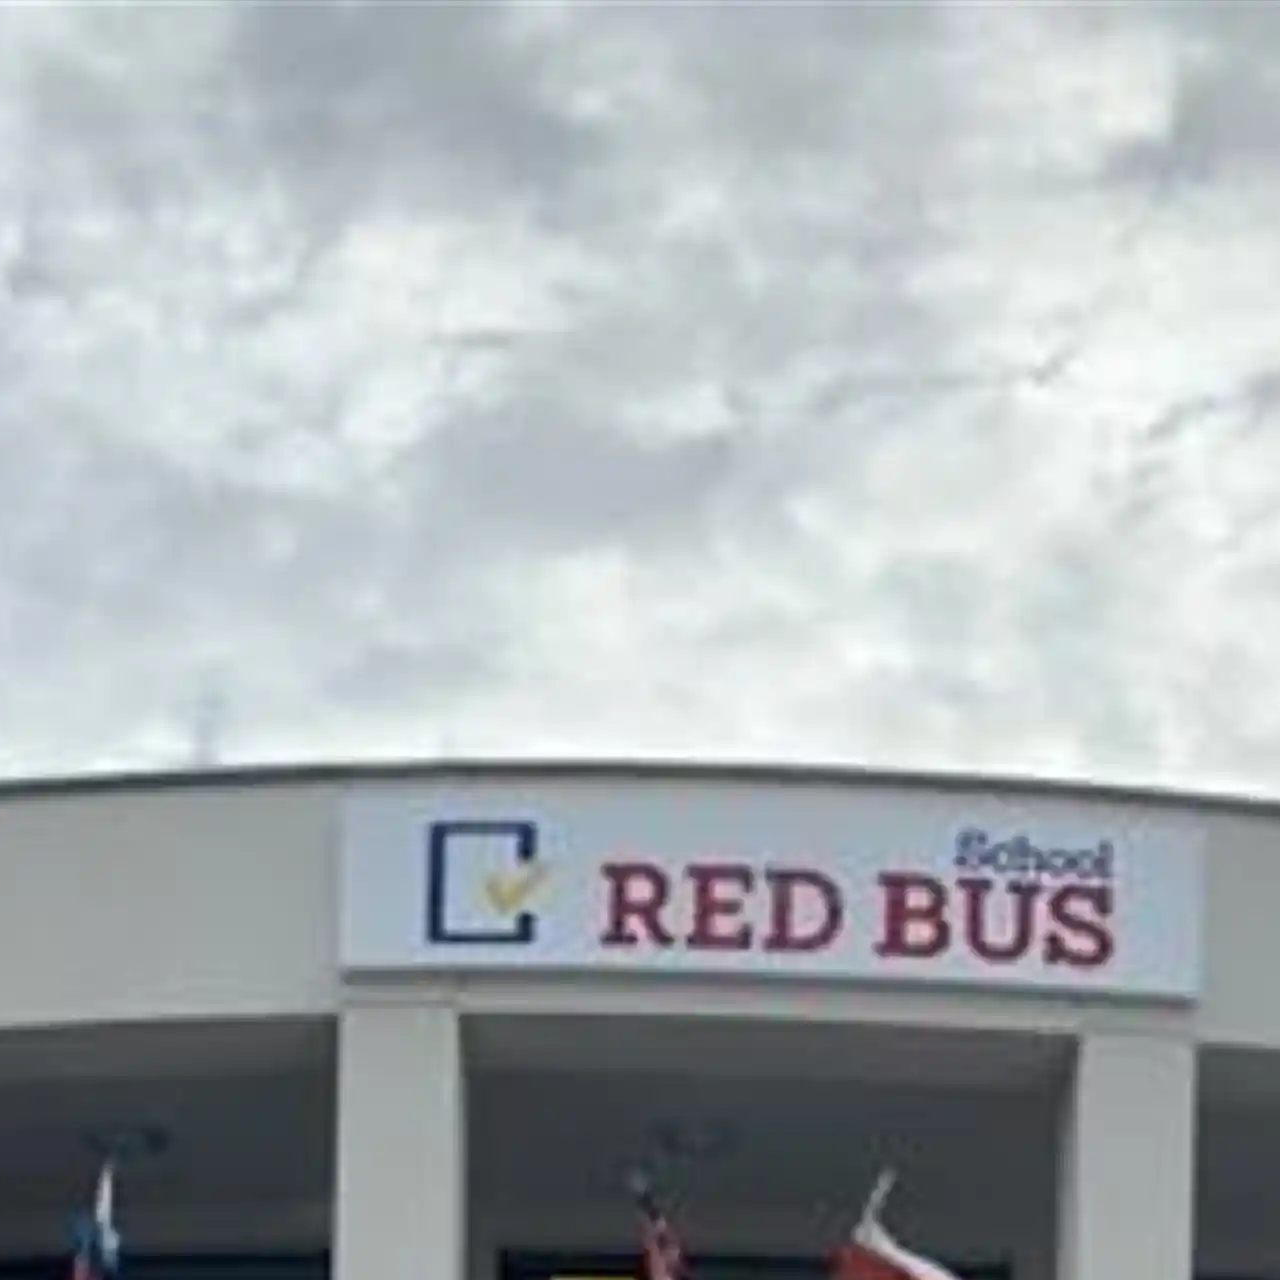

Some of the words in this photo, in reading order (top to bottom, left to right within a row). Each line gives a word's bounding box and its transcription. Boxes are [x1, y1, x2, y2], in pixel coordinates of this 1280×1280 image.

[955, 829, 1114, 876] School
[599, 862, 843, 951] RED
[874, 872, 1116, 967] BUS
